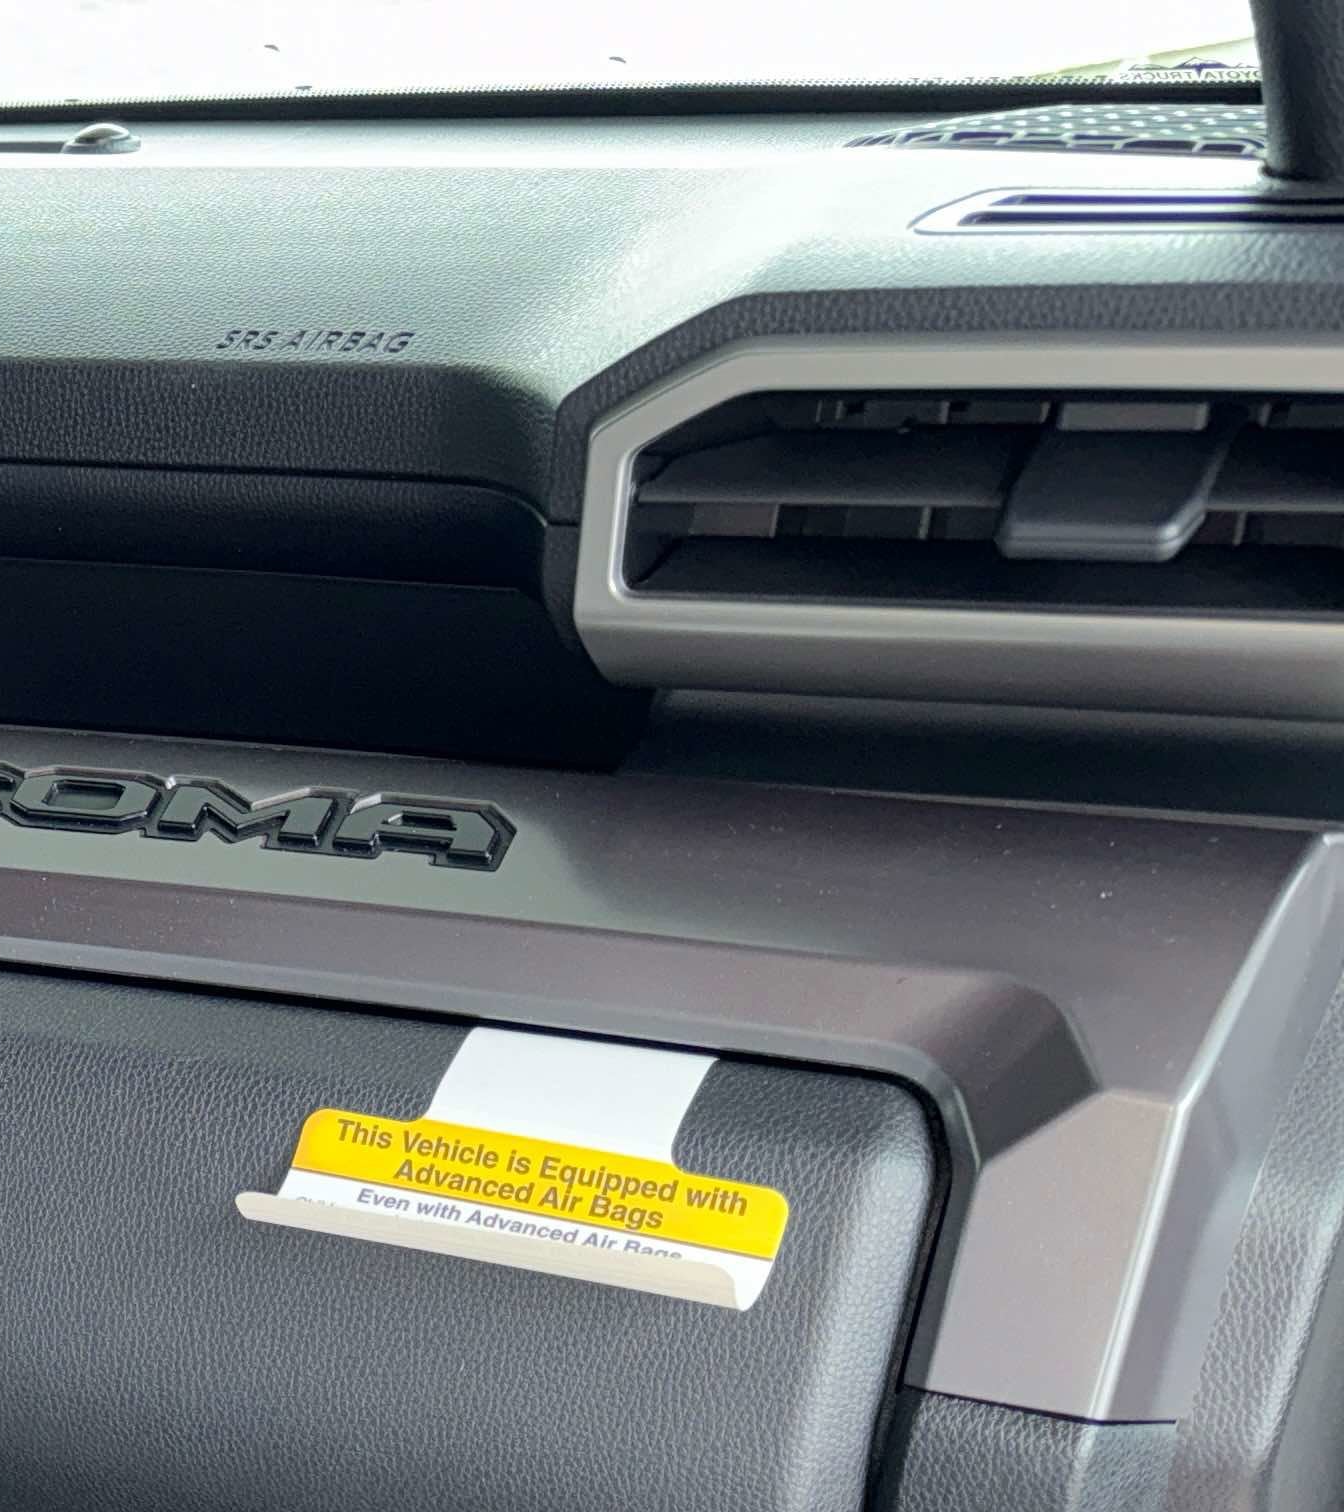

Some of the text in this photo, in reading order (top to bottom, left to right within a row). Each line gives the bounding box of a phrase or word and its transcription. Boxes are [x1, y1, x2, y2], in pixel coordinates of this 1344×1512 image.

[215, 329, 415, 353] SRS AIRBAG
[337, 1118, 748, 1217] This Vehicle is Equipped with
[393, 1159, 664, 1230] Advanced Air Bags
[357, 1188, 410, 1211] Even
[416, 1200, 461, 1221] with
[465, 1210, 579, 1244] Advanced
[582, 1232, 618, 1248] Air
